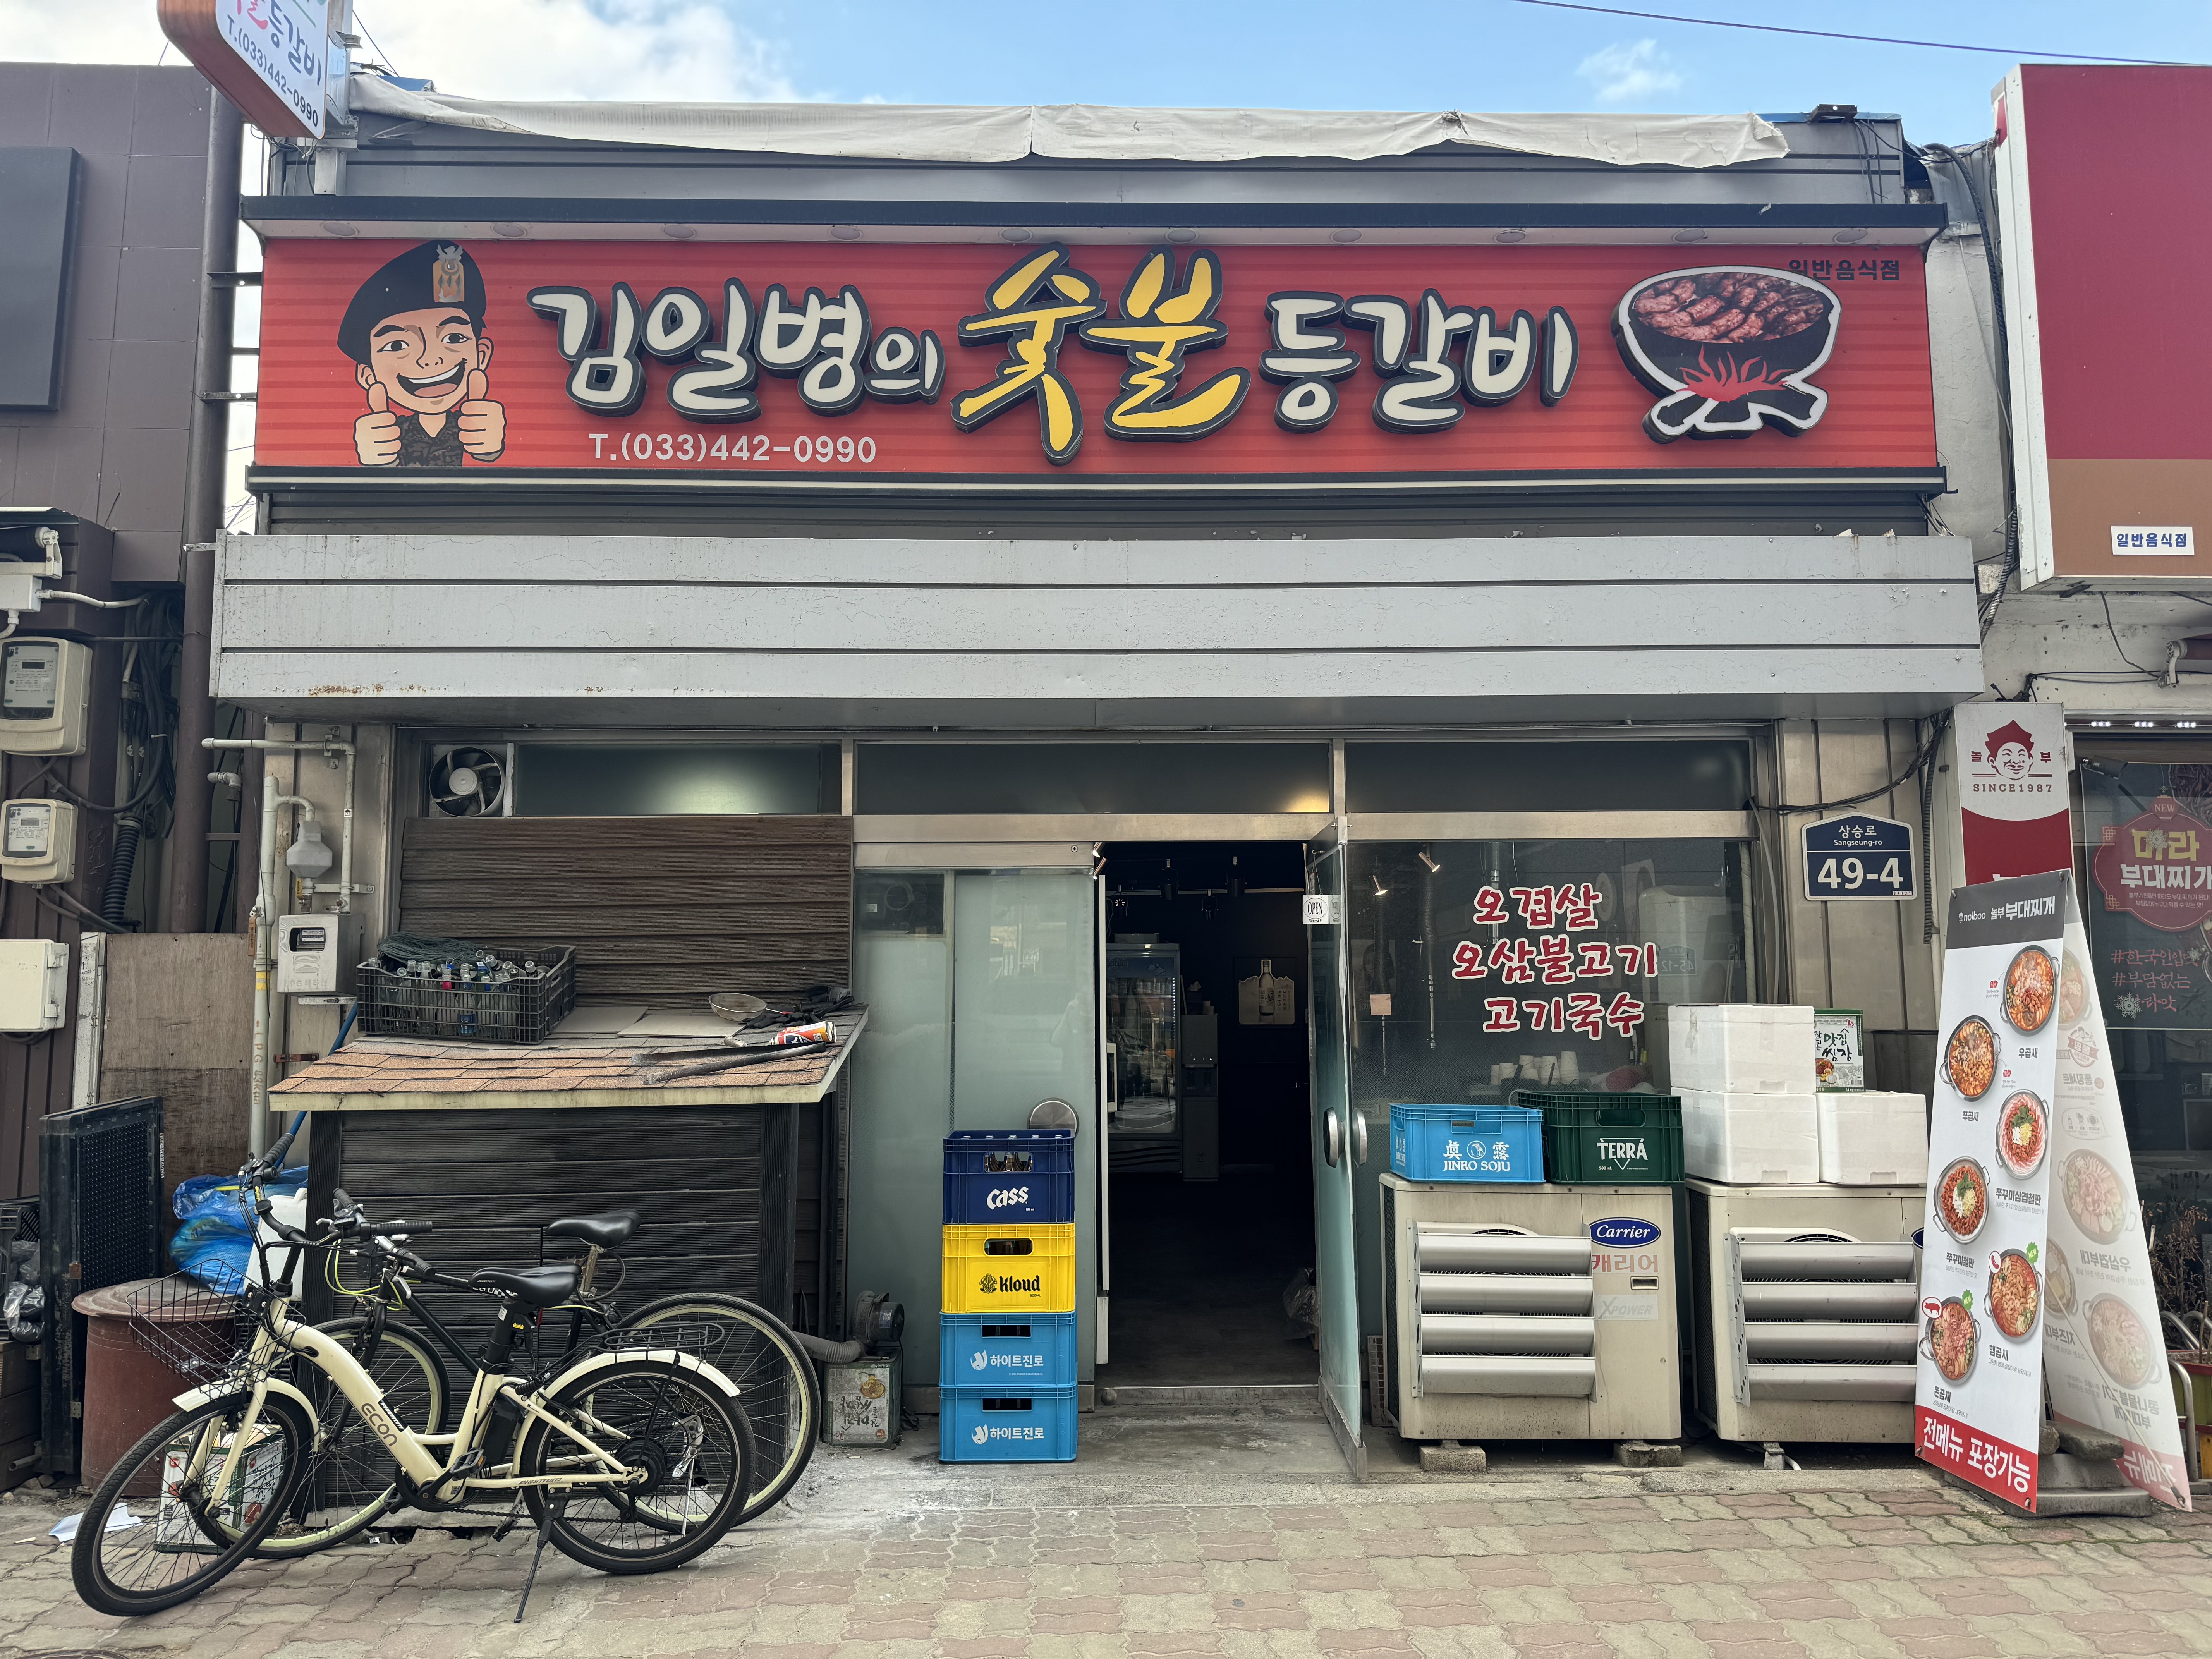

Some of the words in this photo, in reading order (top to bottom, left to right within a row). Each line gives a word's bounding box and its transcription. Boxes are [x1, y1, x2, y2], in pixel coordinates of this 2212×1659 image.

[227, 14, 318, 127] T.(033)442-0990
[1788, 259, 1900, 281] 일반음식점
[526, 277, 946, 423] 김일병의
[951, 242, 1251, 467] 숯불
[1259, 288, 1578, 434] 등갈비
[588, 433, 877, 463] T.(033)442-0990
[2117, 533, 2187, 548] 일반음식점
[2155, 804, 2175, 812] NEW
[1838, 825, 1877, 839] 상승로
[2132, 830, 2200, 861] 마라
[1817, 857, 1903, 889] 49-4
[1308, 902, 1323, 915] OPEN
[1473, 883, 1602, 931] 오겹살
[1964, 910, 1986, 922] nolboo
[1991, 907, 2004, 920] 놀부
[2006, 896, 2055, 920] 부대찌개
[1452, 934, 1658, 984] 오삼불고기
[2114, 993, 2177, 1012] 라맛
[1483, 991, 1644, 1040] 고기국수
[1823, 1032, 1847, 1048] 맛집
[1822, 1044, 1852, 1062] 쌈장
[2018, 1048, 2038, 1058] 우곱새
[1443, 1160, 1478, 1172] JINRO
[1480, 1160, 1510, 1172] SOJU
[1996, 1188, 2041, 1206] 쭈꾸미삼겹철판
[1596, 1225, 1651, 1238] Carrier
[1946, 1252, 1975, 1269] 쭈꾸미철판
[2028, 1248, 2037, 1259] NEW
[1592, 1254, 1658, 1273] 캐리어
[990, 1354, 1044, 1368] 하이트진로
[1989, 1344, 2009, 1361] 햄곱새
[1934, 1386, 1951, 1404] 돈곱새
[361, 1403, 397, 1446] ECON
[380, 1402, 404, 1430] PHANTOM
[990, 1427, 1044, 1441] 하이트진로
[1923, 1417, 1963, 1462] 전메뉴
[1967, 1437, 2031, 1493] 포장가능
